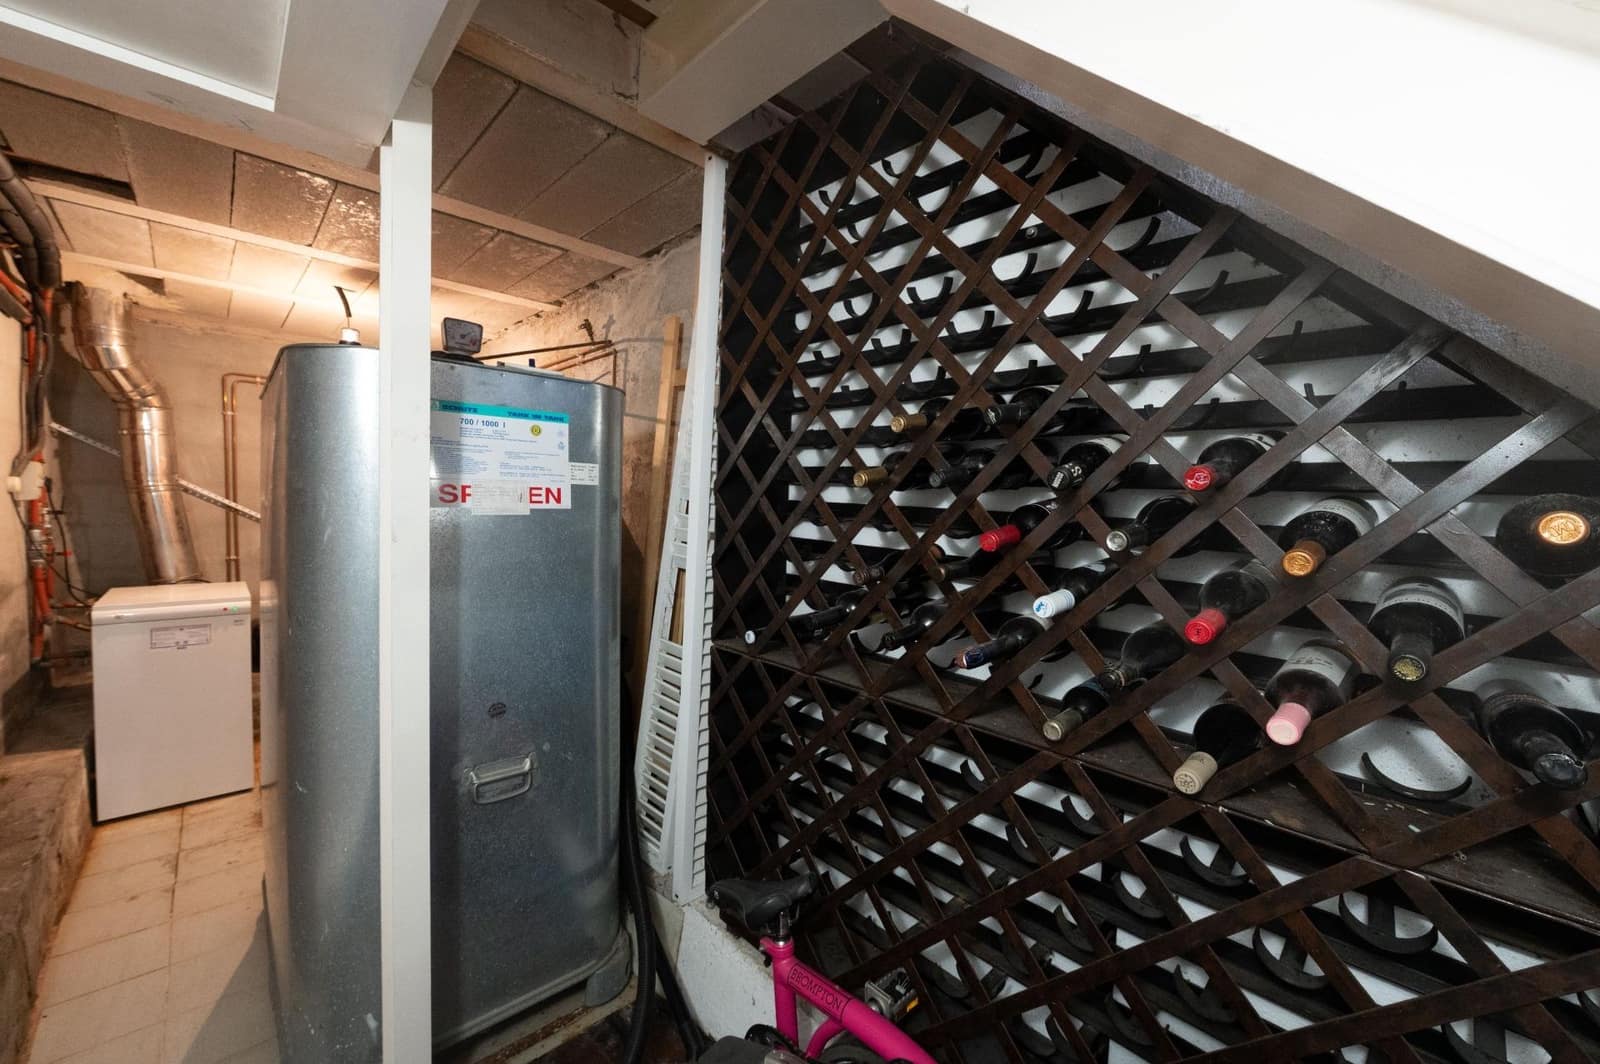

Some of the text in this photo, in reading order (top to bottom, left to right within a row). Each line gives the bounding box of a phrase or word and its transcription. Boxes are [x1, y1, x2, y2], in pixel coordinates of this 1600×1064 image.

[459, 417, 474, 426] 700
[481, 420, 499, 428] 1000
[791, 967, 842, 1008] BROMPTON
